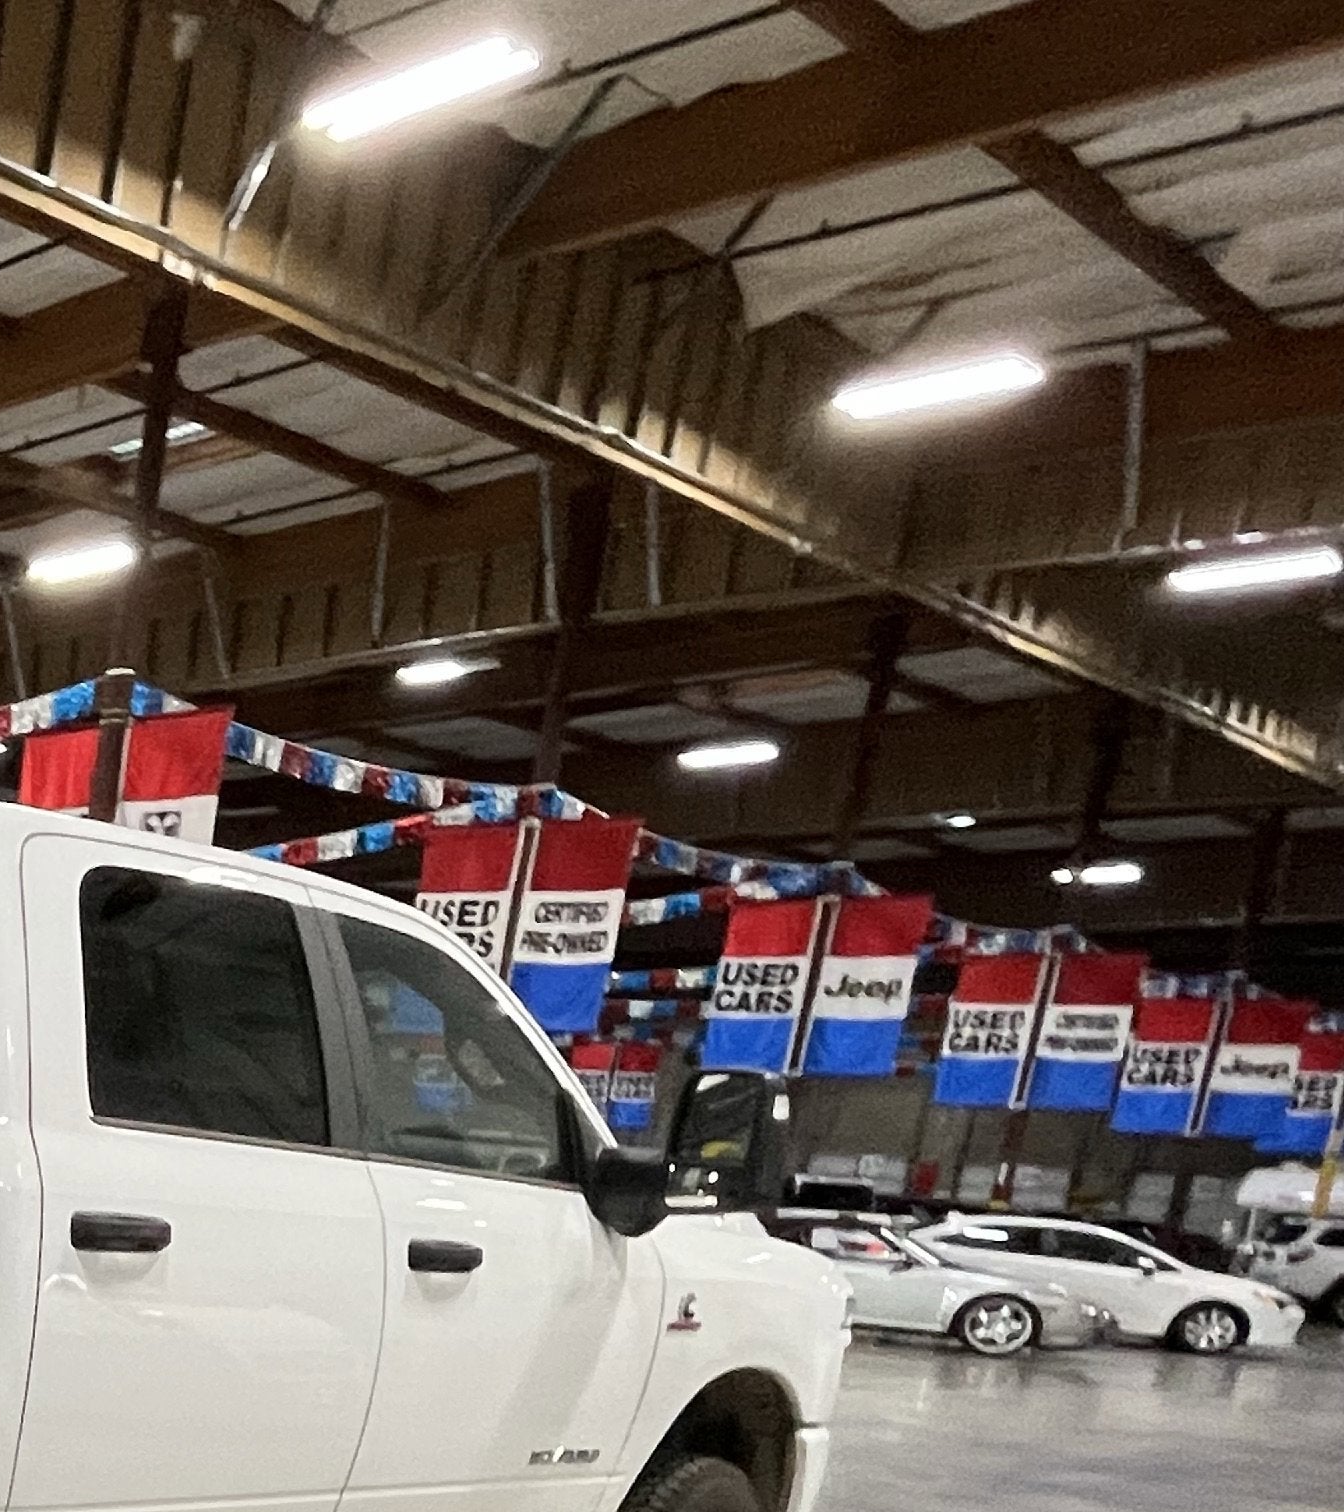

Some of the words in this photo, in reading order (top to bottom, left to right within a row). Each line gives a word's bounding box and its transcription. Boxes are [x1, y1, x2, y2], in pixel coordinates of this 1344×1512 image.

[420, 898, 500, 927] USED
[721, 962, 800, 987] USED
[823, 973, 903, 1005] Jeep
[714, 989, 793, 1014] CARS
[953, 1009, 1026, 1031] USED
[948, 1031, 1019, 1054] CARS
[1132, 1047, 1202, 1064] USED
[1127, 1064, 1195, 1087] CARS
